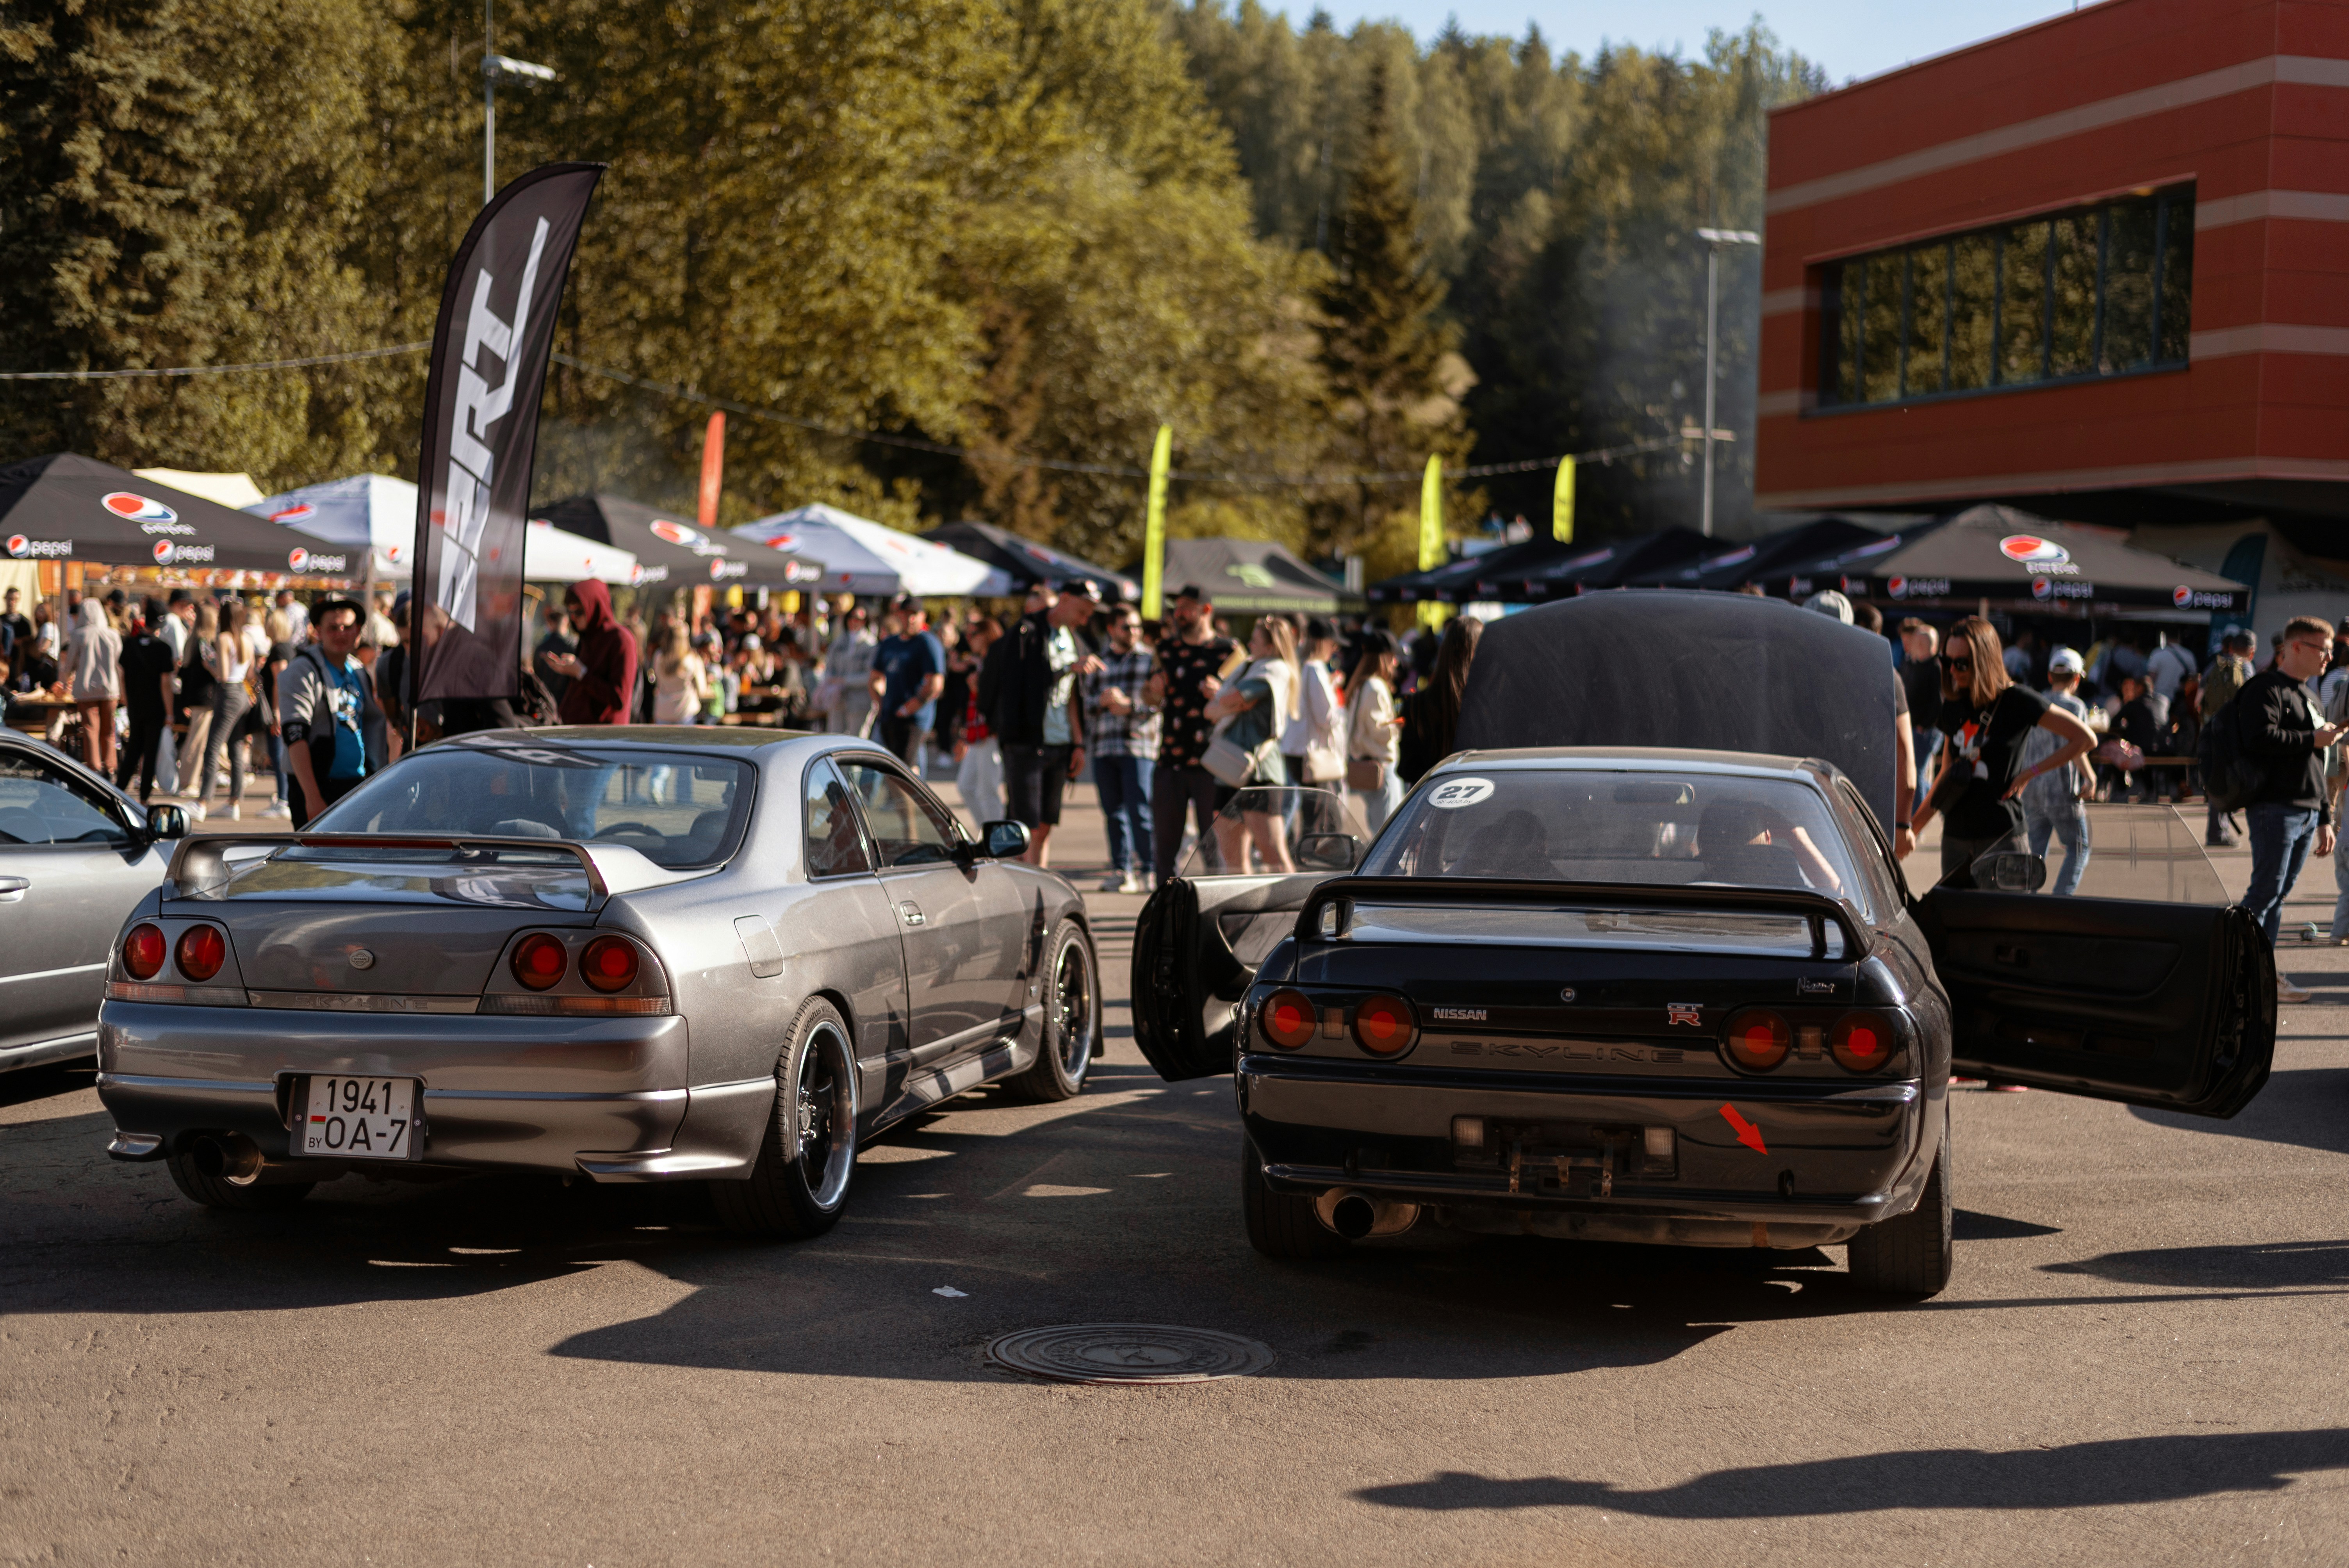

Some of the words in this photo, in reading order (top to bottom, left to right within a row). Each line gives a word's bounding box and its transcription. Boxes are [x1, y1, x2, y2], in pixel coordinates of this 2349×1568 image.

[30, 539, 73, 558] pepsi
[175, 544, 214, 563] pepsi
[308, 554, 346, 573] pepsi
[2053, 581, 2093, 599] pepsi
[2194, 592, 2233, 609] pepsi
[1436, 786, 1485, 799] 27
[295, 996, 428, 1010] SKYLINE
[1668, 1003, 1704, 1011] GT
[1434, 1008, 1486, 1020] NISSAN
[1669, 1011, 1701, 1026] R
[1451, 1042, 1684, 1064] SKYLINE
[328, 1079, 392, 1114] 1941
[325, 1116, 406, 1151] OA-7
[309, 1137, 322, 1148] BY
